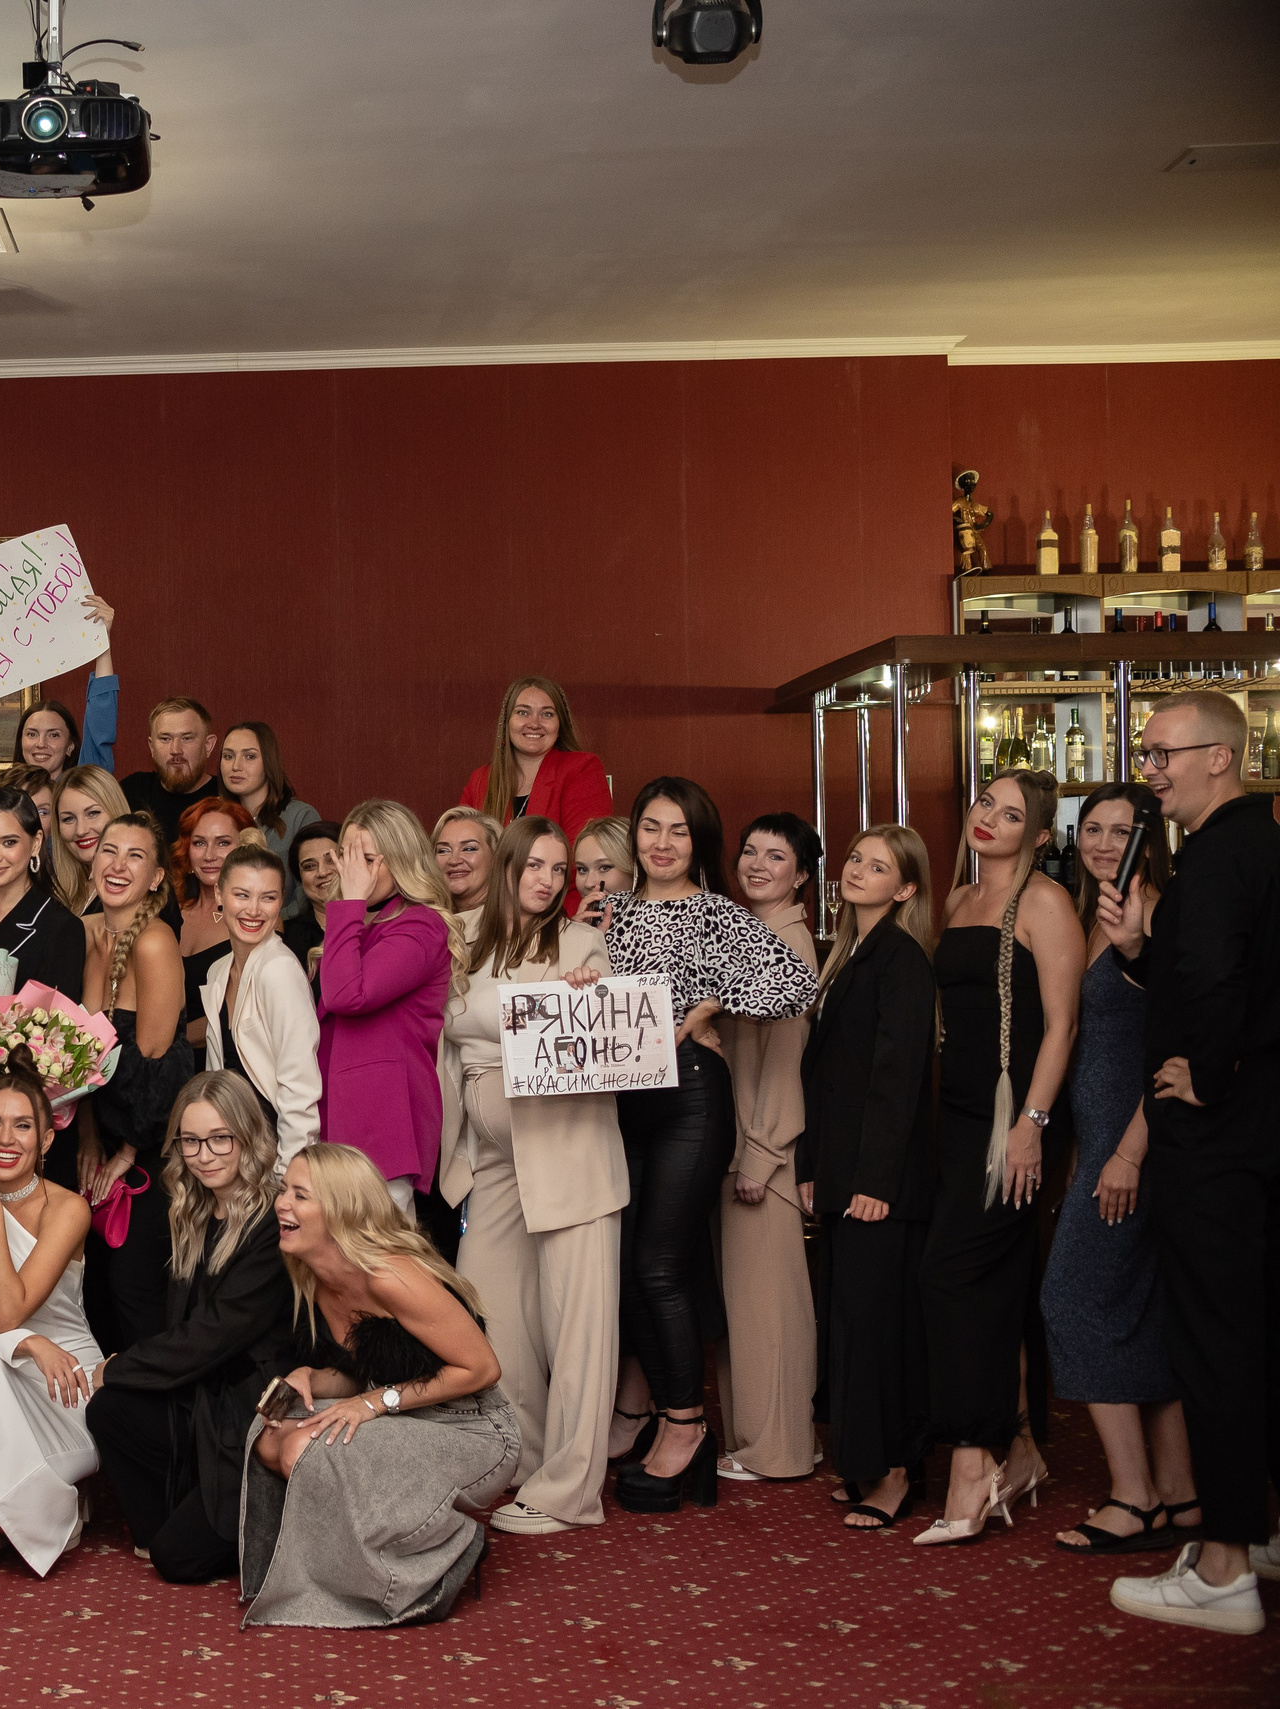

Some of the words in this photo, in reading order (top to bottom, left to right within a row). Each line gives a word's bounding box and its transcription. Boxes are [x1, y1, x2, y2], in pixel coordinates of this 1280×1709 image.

[636, 974, 669, 987] 19.08.23
[511, 991, 658, 1036] РЯКИНА
[535, 1026, 646, 1069] АГОНЬ!
